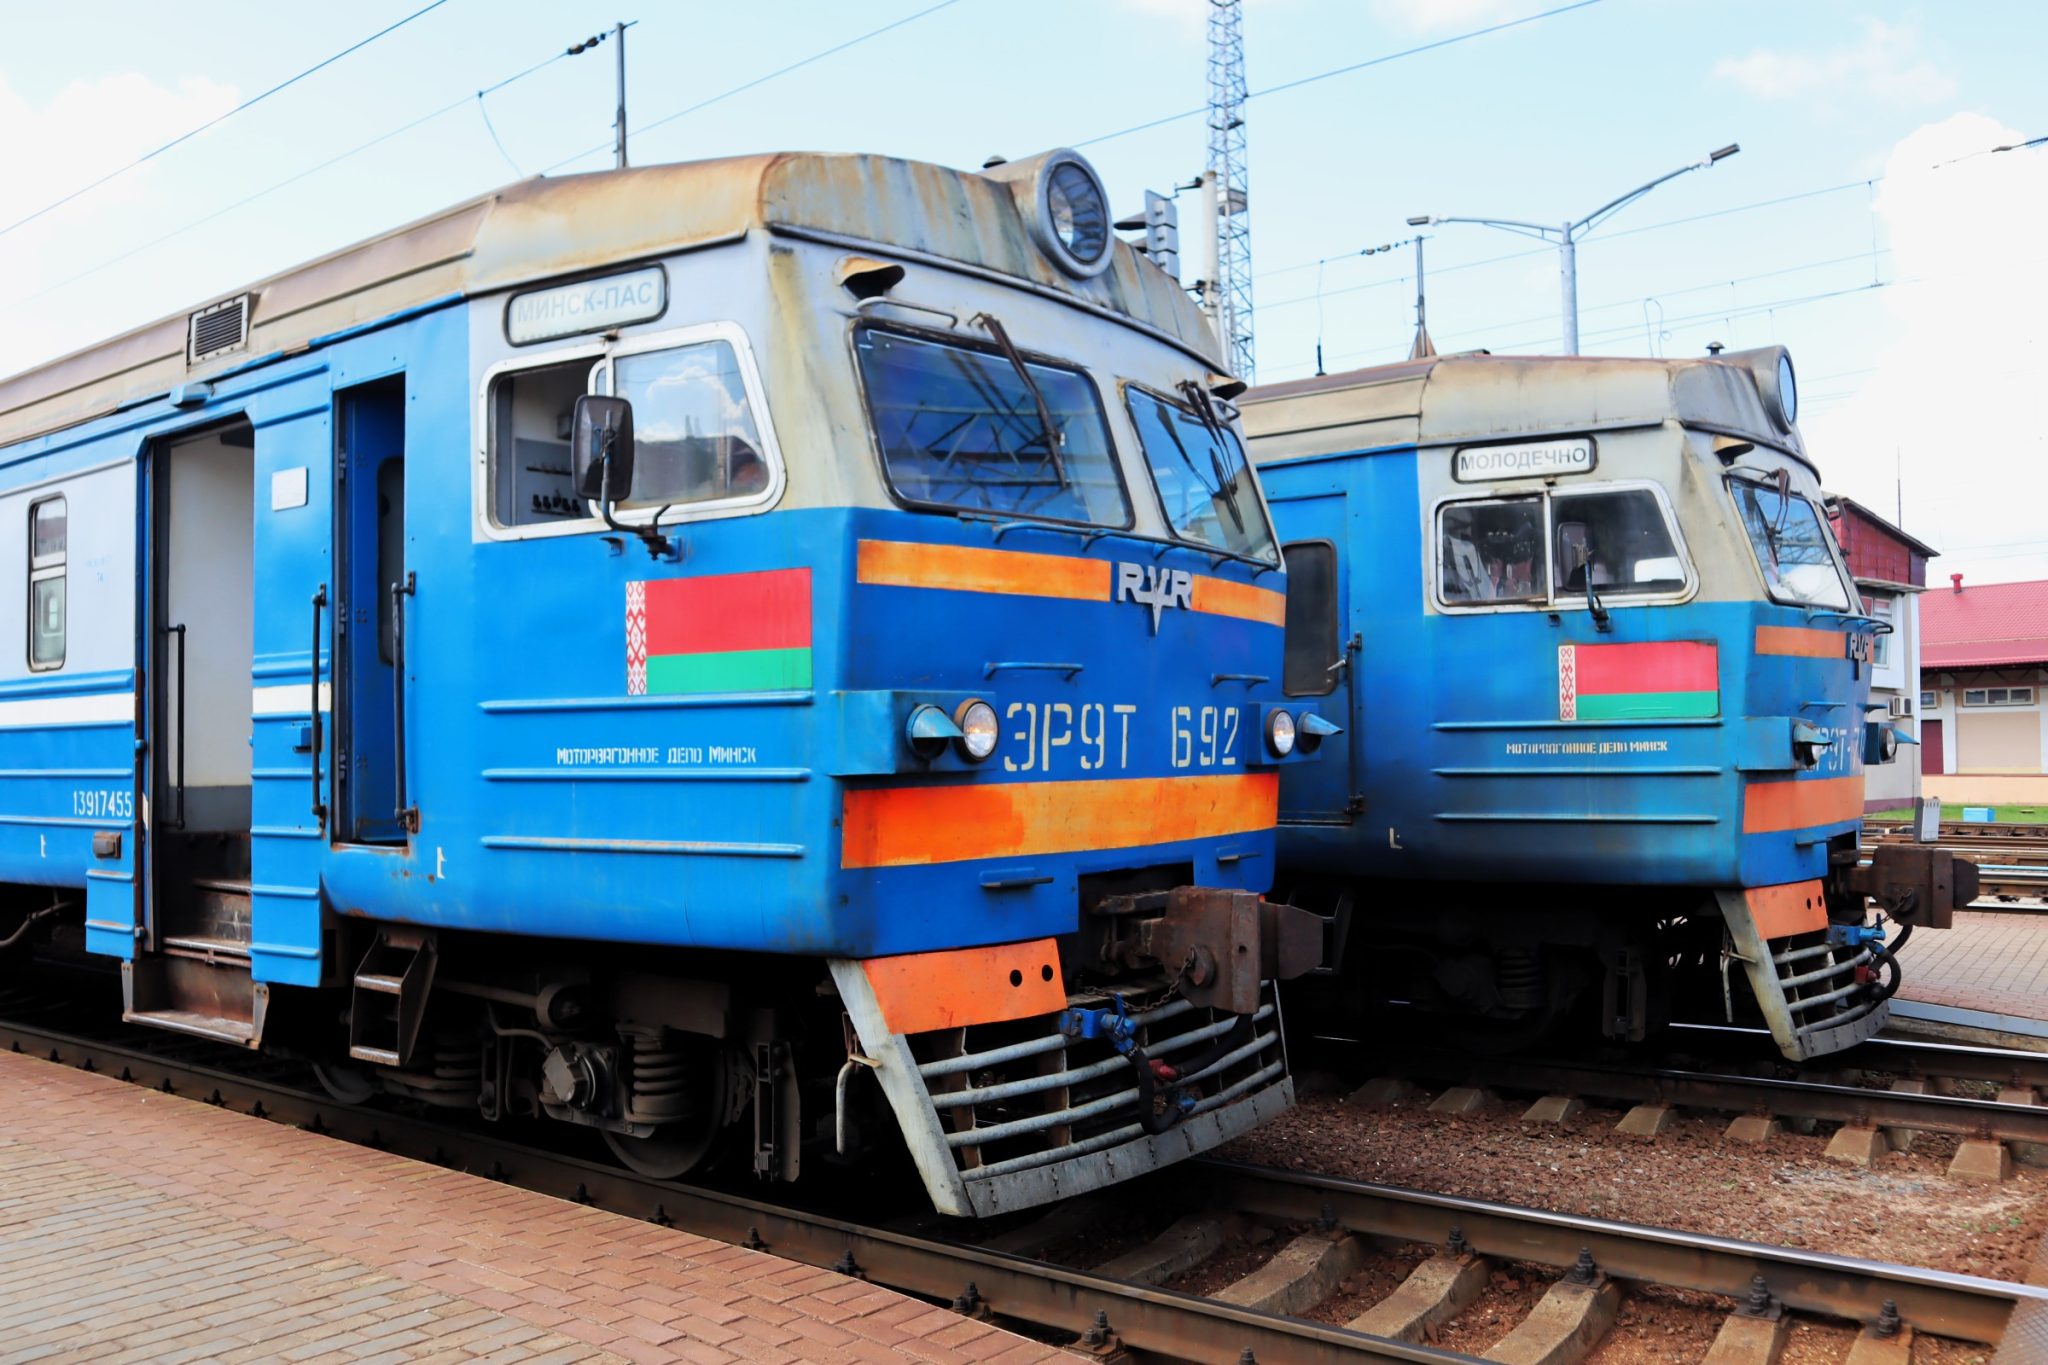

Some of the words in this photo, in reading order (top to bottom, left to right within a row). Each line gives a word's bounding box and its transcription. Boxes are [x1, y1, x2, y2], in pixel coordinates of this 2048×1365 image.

[517, 281, 653, 322] МИНСК-ПАС
[1460, 447, 1587, 470] МОЛОДЕЧНО
[1118, 562, 1193, 635] RVR
[1004, 703, 1137, 771] ЭР9Т
[1171, 706, 1239, 768] 692
[73, 790, 132, 817] 13917455
